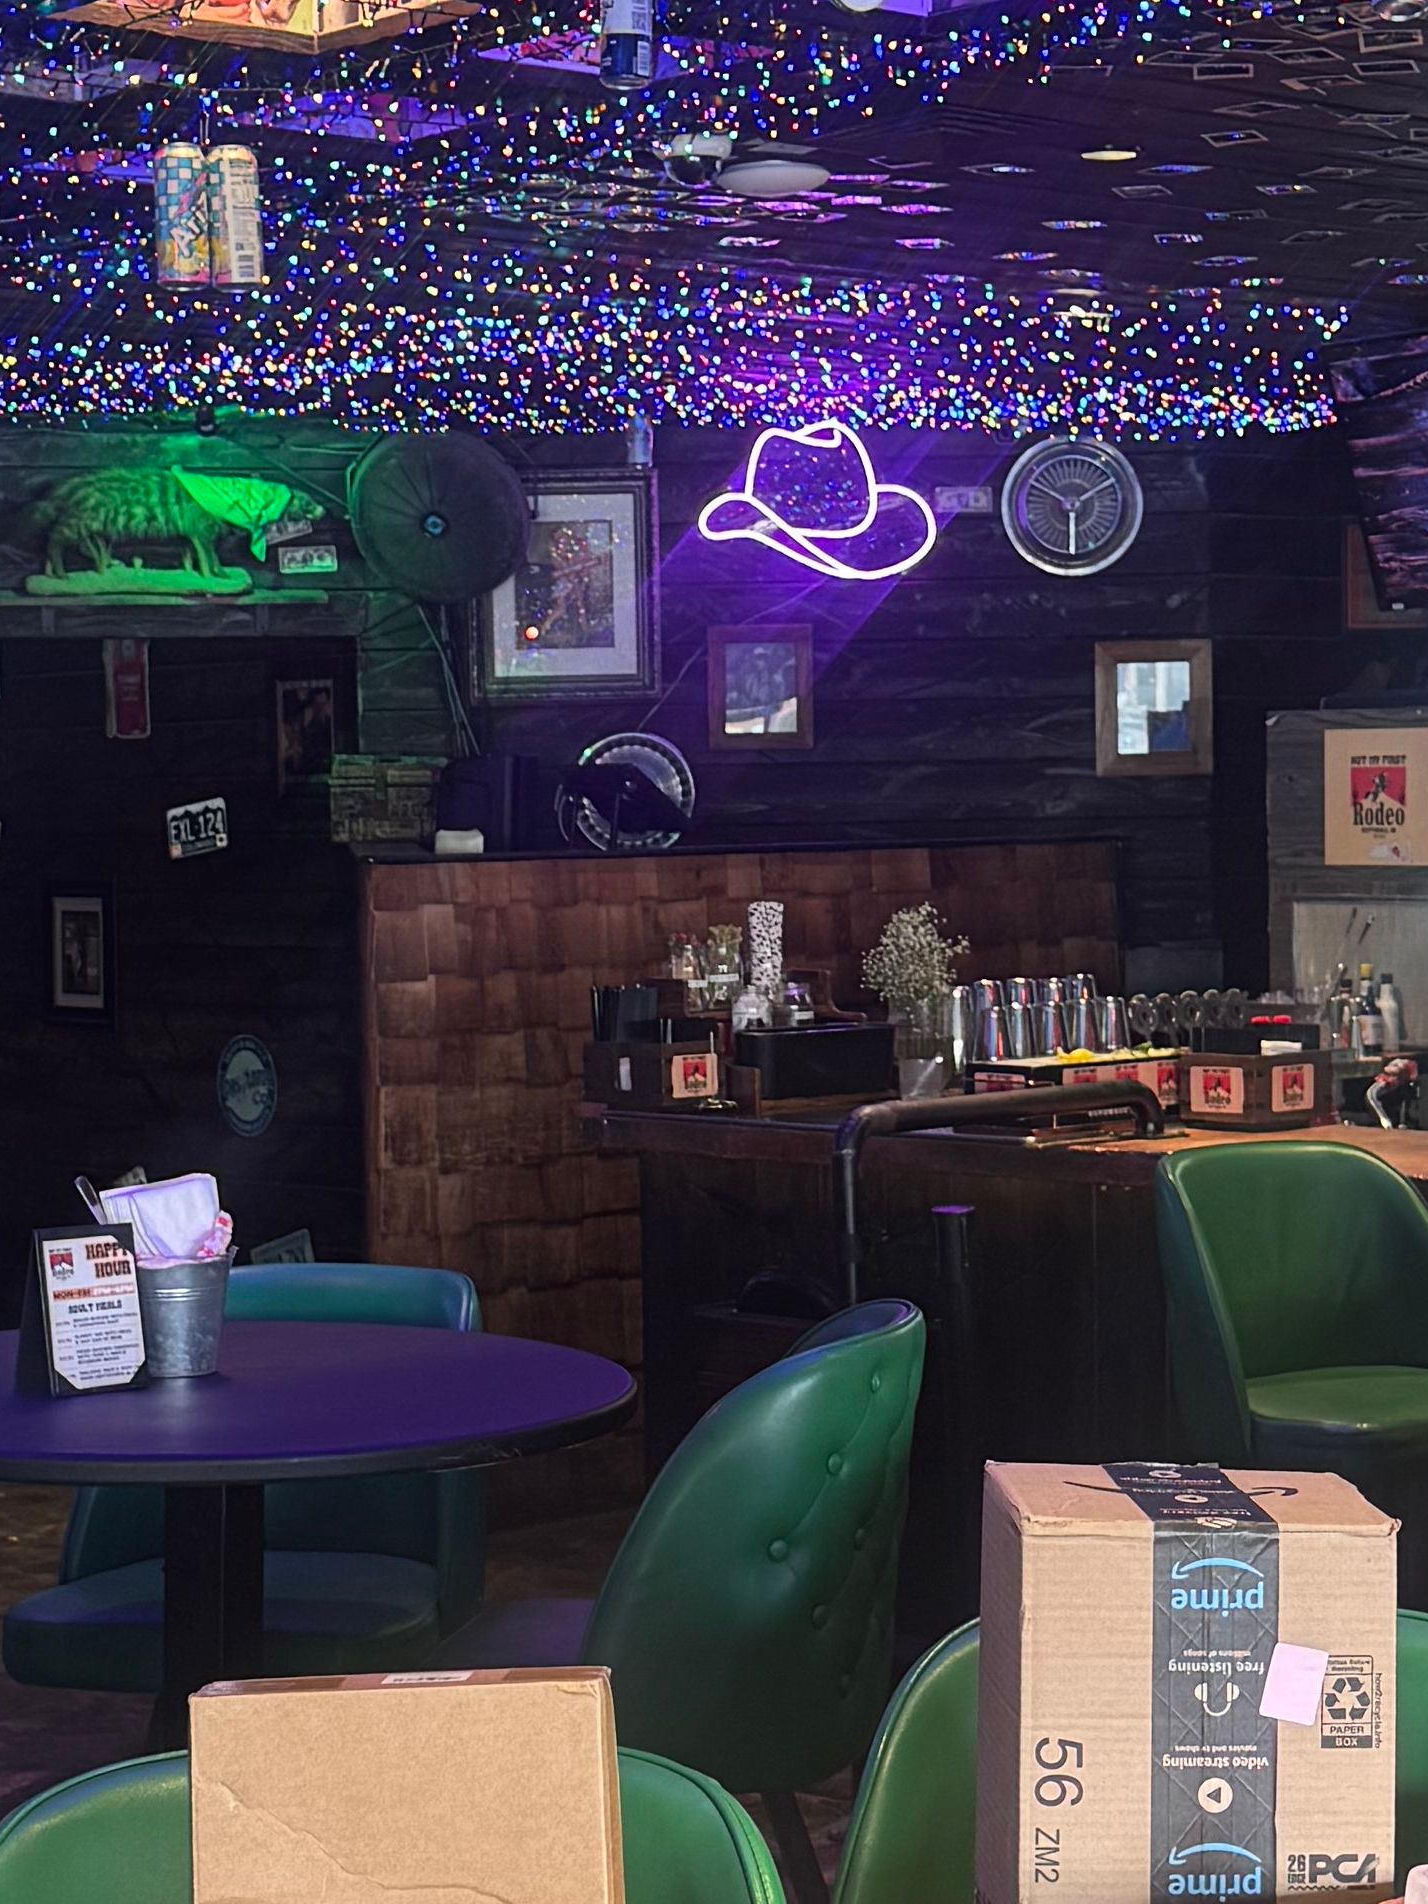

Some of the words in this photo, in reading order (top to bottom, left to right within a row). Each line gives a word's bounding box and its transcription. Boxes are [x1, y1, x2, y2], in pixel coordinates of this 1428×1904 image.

[1353, 801, 1405, 826] Rodeo
[85, 1242, 128, 1260] HAPPY
[95, 1260, 132, 1279] HOUR
[1172, 1581, 1264, 1618] prime
[1168, 1661, 1232, 1677] listening
[1236, 1662, 1264, 1674] free
[1330, 1725, 1364, 1734] PAPER
[1335, 1737, 1358, 1746] BOX
[1163, 1755, 1230, 1769] streaming
[1233, 1755, 1269, 1768] video
[1035, 1737, 1084, 1807] 56
[1035, 1827, 1060, 1883] ZM2
[1287, 1856, 1306, 1872] 26
[1308, 1853, 1376, 1884] PCA
[1168, 1867, 1262, 1903] prime
[1287, 1873, 1306, 1885] EDGE
